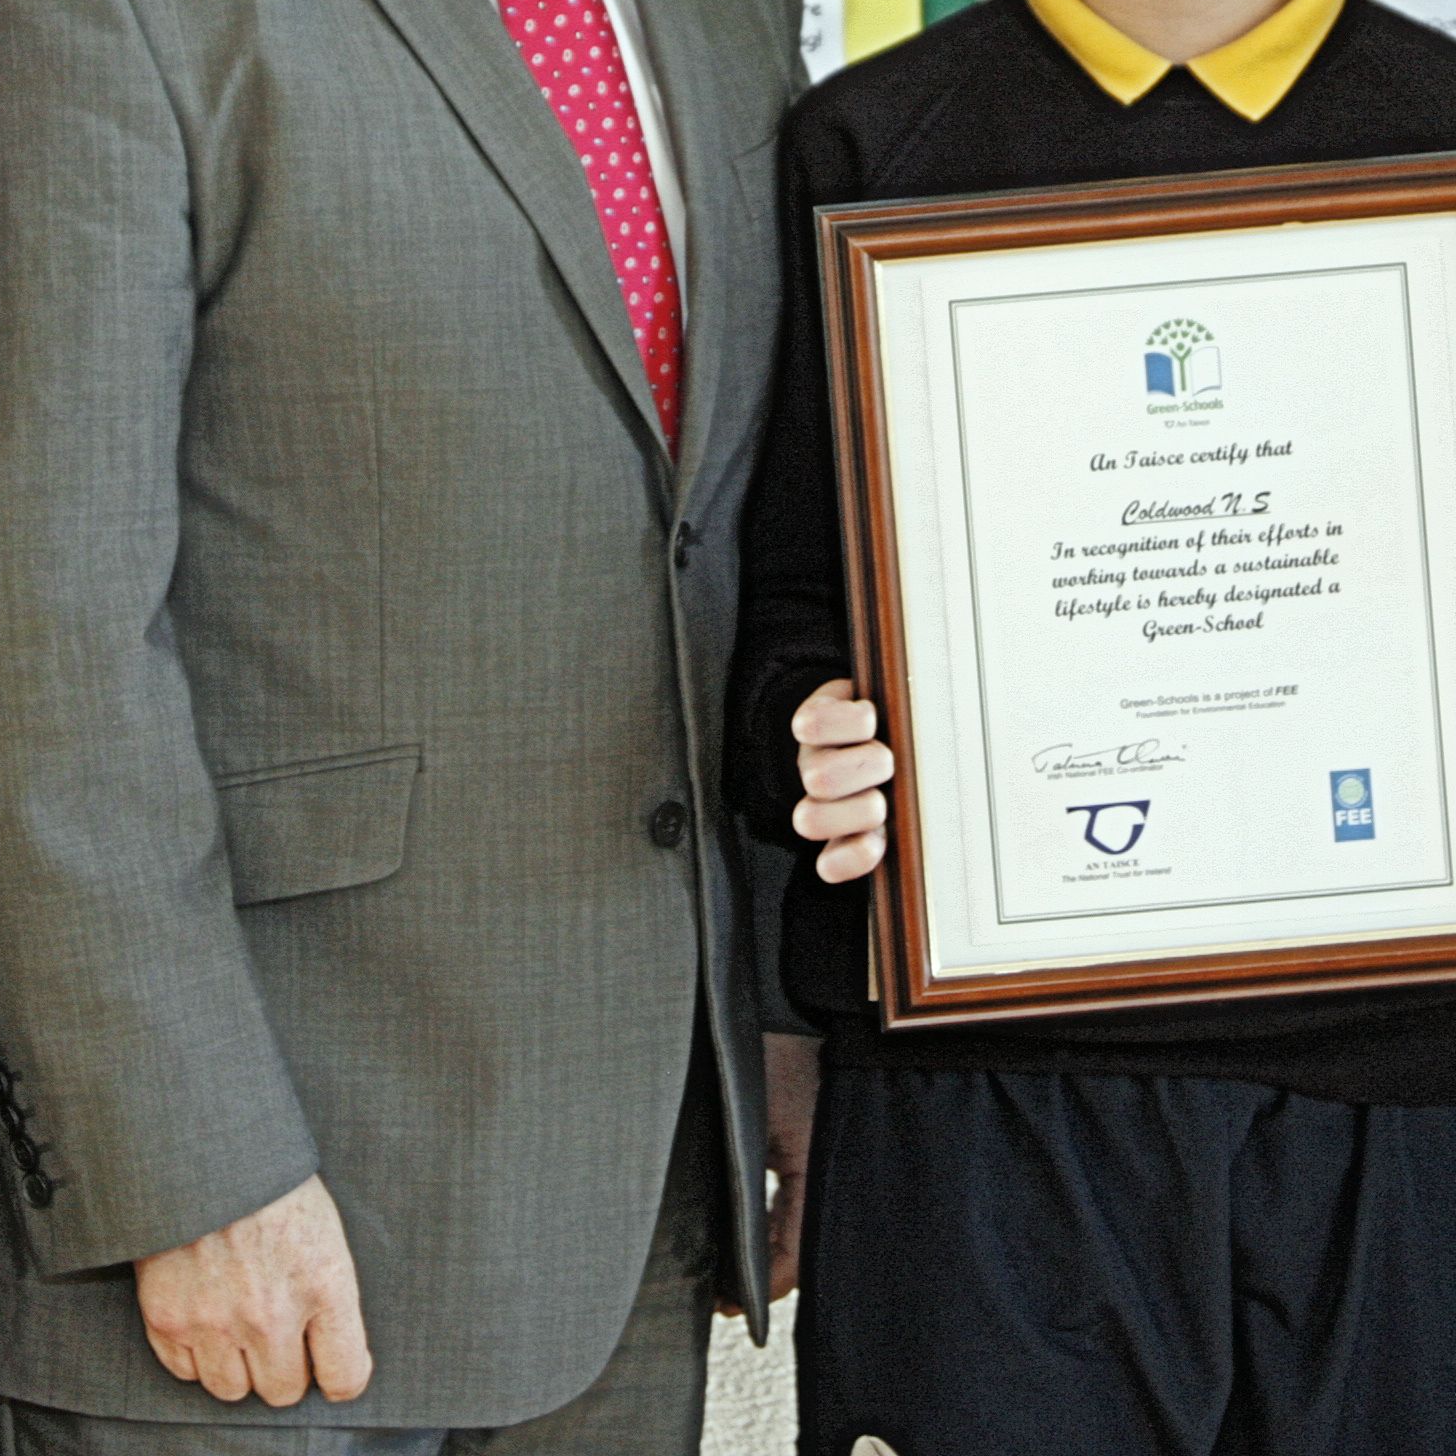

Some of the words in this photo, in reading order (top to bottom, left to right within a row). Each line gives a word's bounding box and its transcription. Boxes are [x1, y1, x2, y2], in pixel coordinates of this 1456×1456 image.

[1089, 453, 1117, 472] An
[1123, 450, 1185, 470] Taisce
[1189, 443, 1249, 466] certify
[1255, 440, 1293, 457] that
[1121, 496, 1216, 526] Coldwood
[1050, 541, 1075, 561] In
[1081, 534, 1180, 559] recognition
[1185, 529, 1206, 553] of
[1211, 527, 1252, 547] their
[1257, 522, 1320, 547] efforts
[1325, 520, 1344, 537] in
[1051, 567, 1127, 589] working
[1132, 559, 1208, 582] towards
[1214, 563, 1227, 575] a
[1232, 547, 1341, 573] sustainable
[1053, 593, 1132, 622] lifestyle
[1136, 594, 1152, 610] is
[1157, 587, 1217, 609] hereby
[1223, 577, 1323, 605] designated
[1328, 581, 1342, 594] a
[1141, 610, 1265, 643] Green-School
[1335, 807, 1373, 827] FEE
